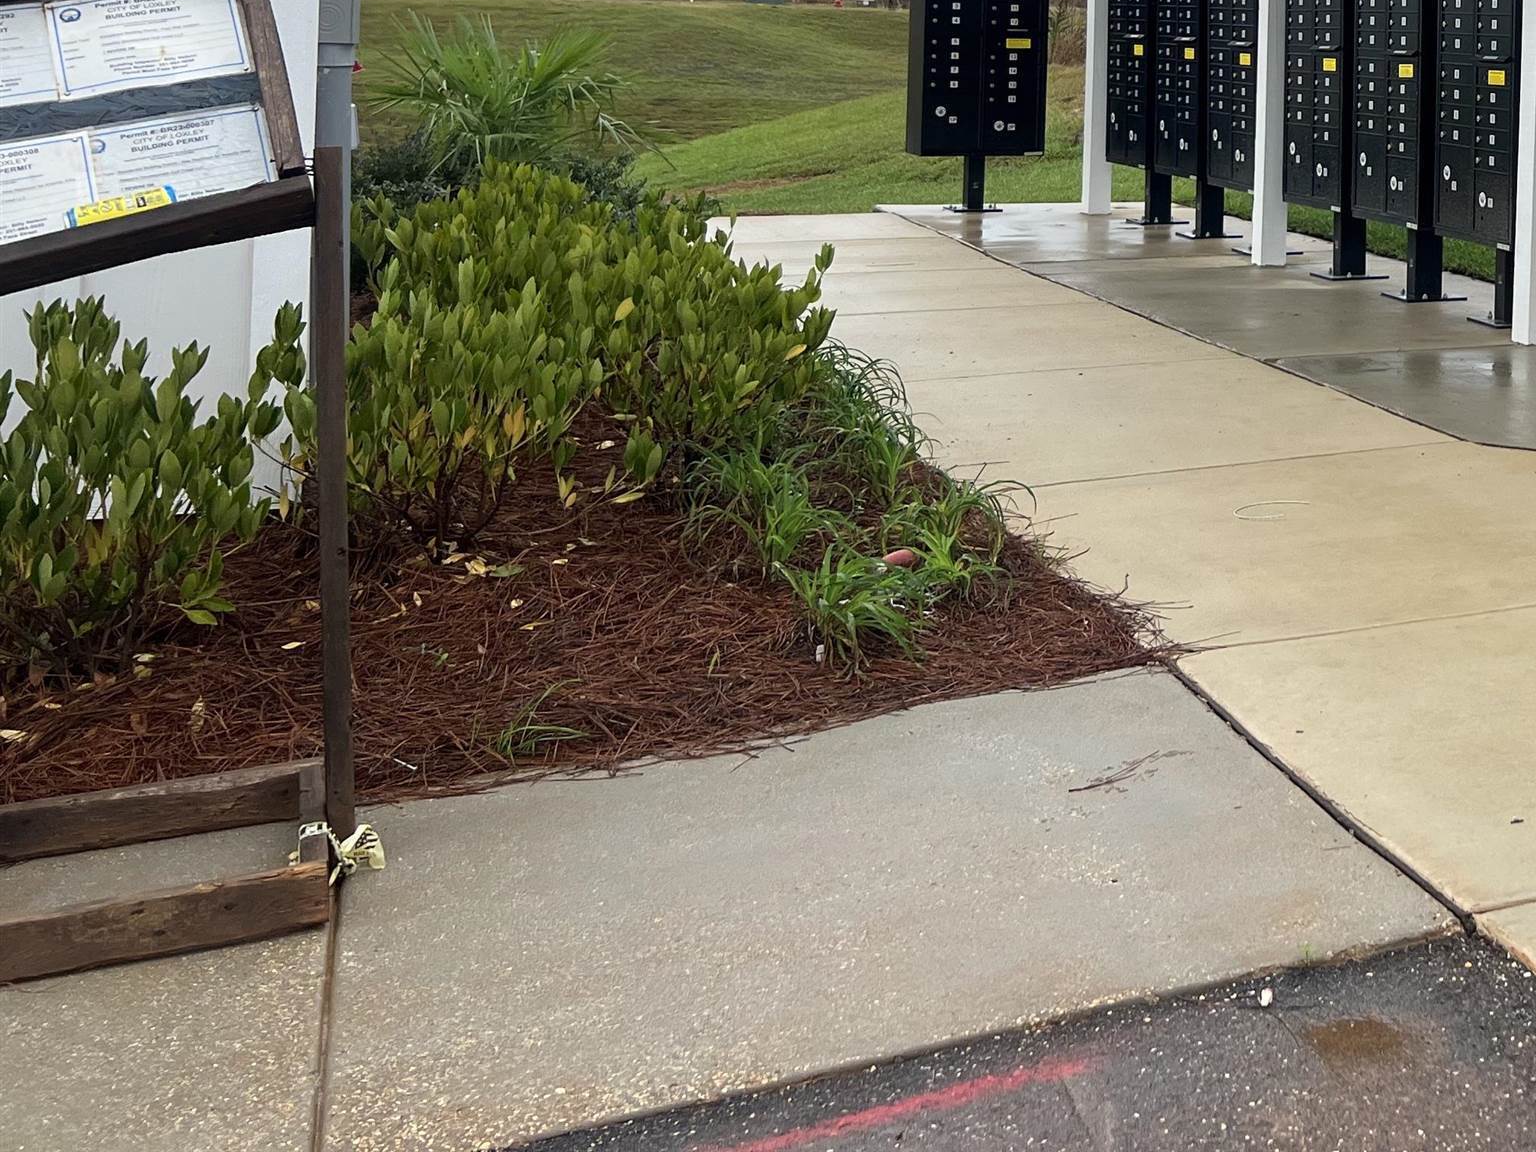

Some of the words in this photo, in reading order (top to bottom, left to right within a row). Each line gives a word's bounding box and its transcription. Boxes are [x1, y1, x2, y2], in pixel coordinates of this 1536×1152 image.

[105, 9, 147, 19] BUILDING
[149, 6, 181, 14] PERMIT
[120, 131, 148, 139] Permit
[131, 140, 174, 152] BUILDING
[176, 135, 209, 145] PERMIT
